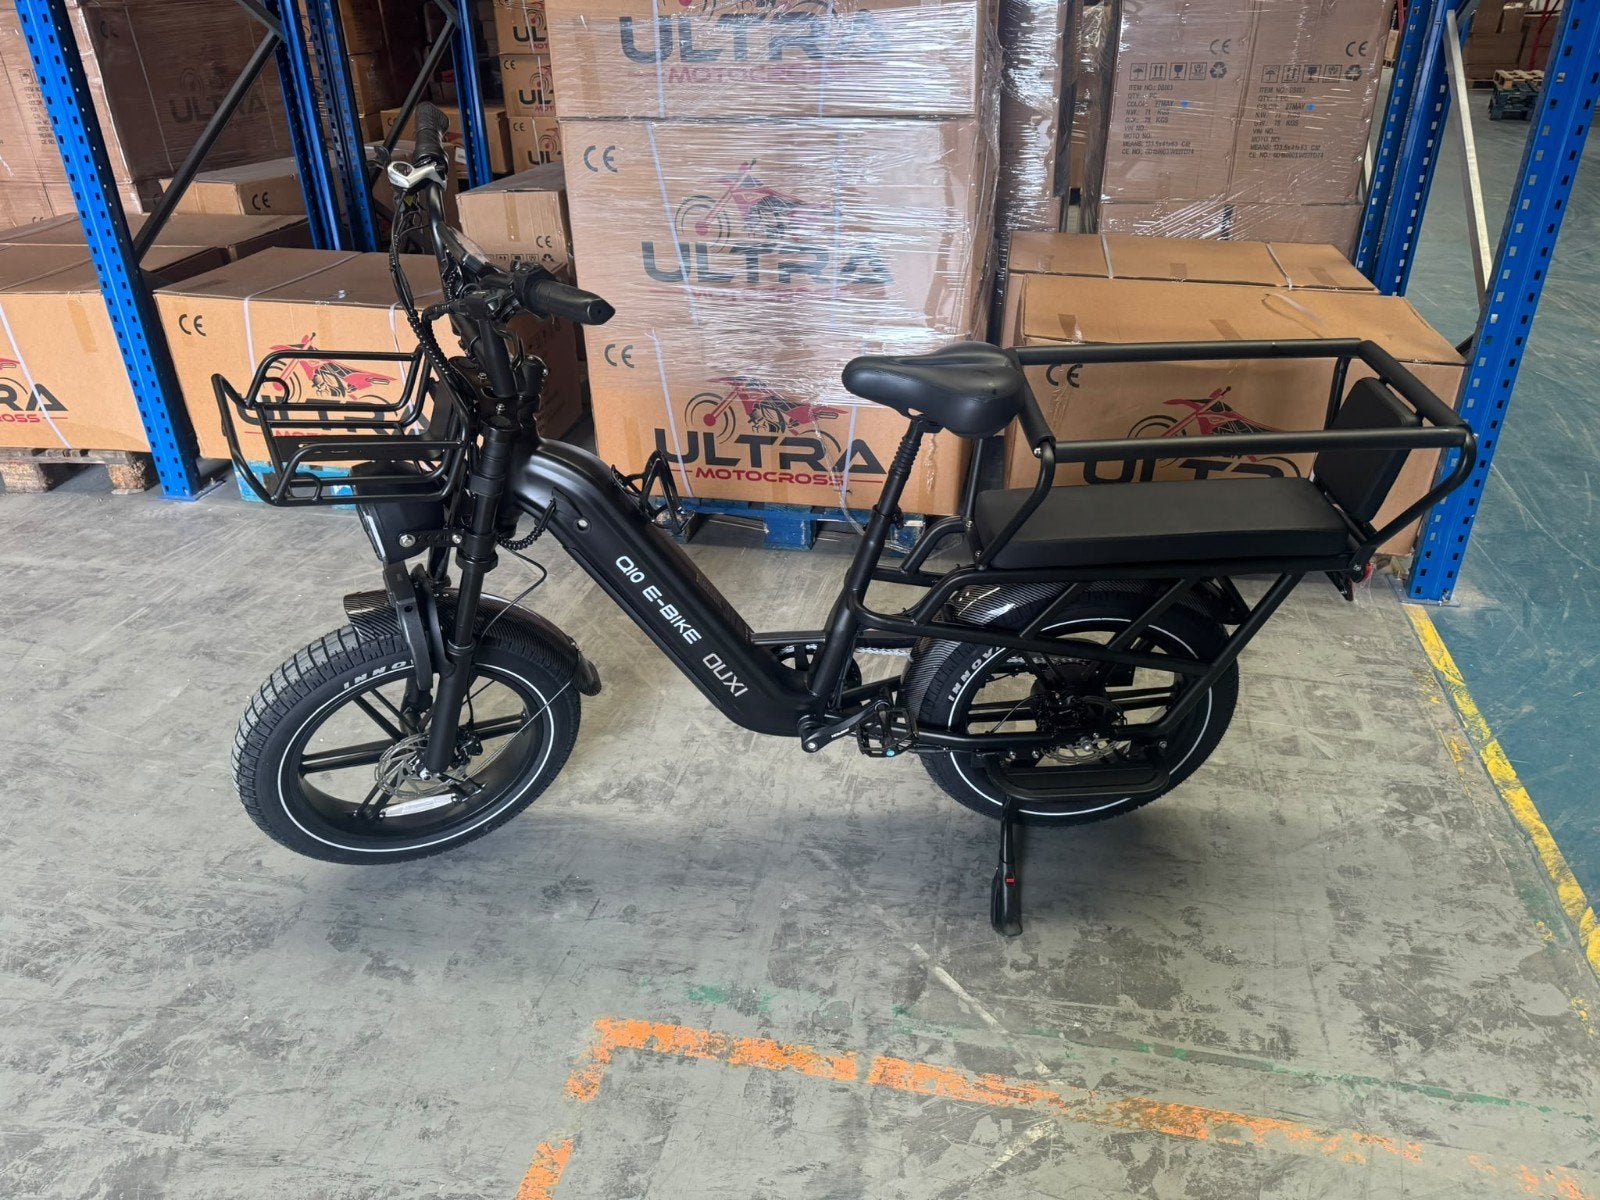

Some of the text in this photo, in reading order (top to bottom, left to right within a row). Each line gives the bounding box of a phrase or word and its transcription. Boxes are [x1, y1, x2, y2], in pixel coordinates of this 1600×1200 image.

[1345, 41, 1368, 57] CE
[584, 145, 618, 173] CE
[252, 191, 271, 210] CE
[536, 235, 552, 248] CE
[641, 240, 894, 284] ULTRA
[178, 313, 206, 337] CE
[604, 343, 635, 369] CE
[1046, 363, 1084, 388] CE
[0, 414, 40, 423] OSS
[654, 428, 887, 474] ULTRA
[695, 467, 844, 486] MOTOCROSS
[642, 585, 702, 644] E-BIKE
[343, 659, 414, 690] INNO
[702, 653, 748, 697] OUXI
